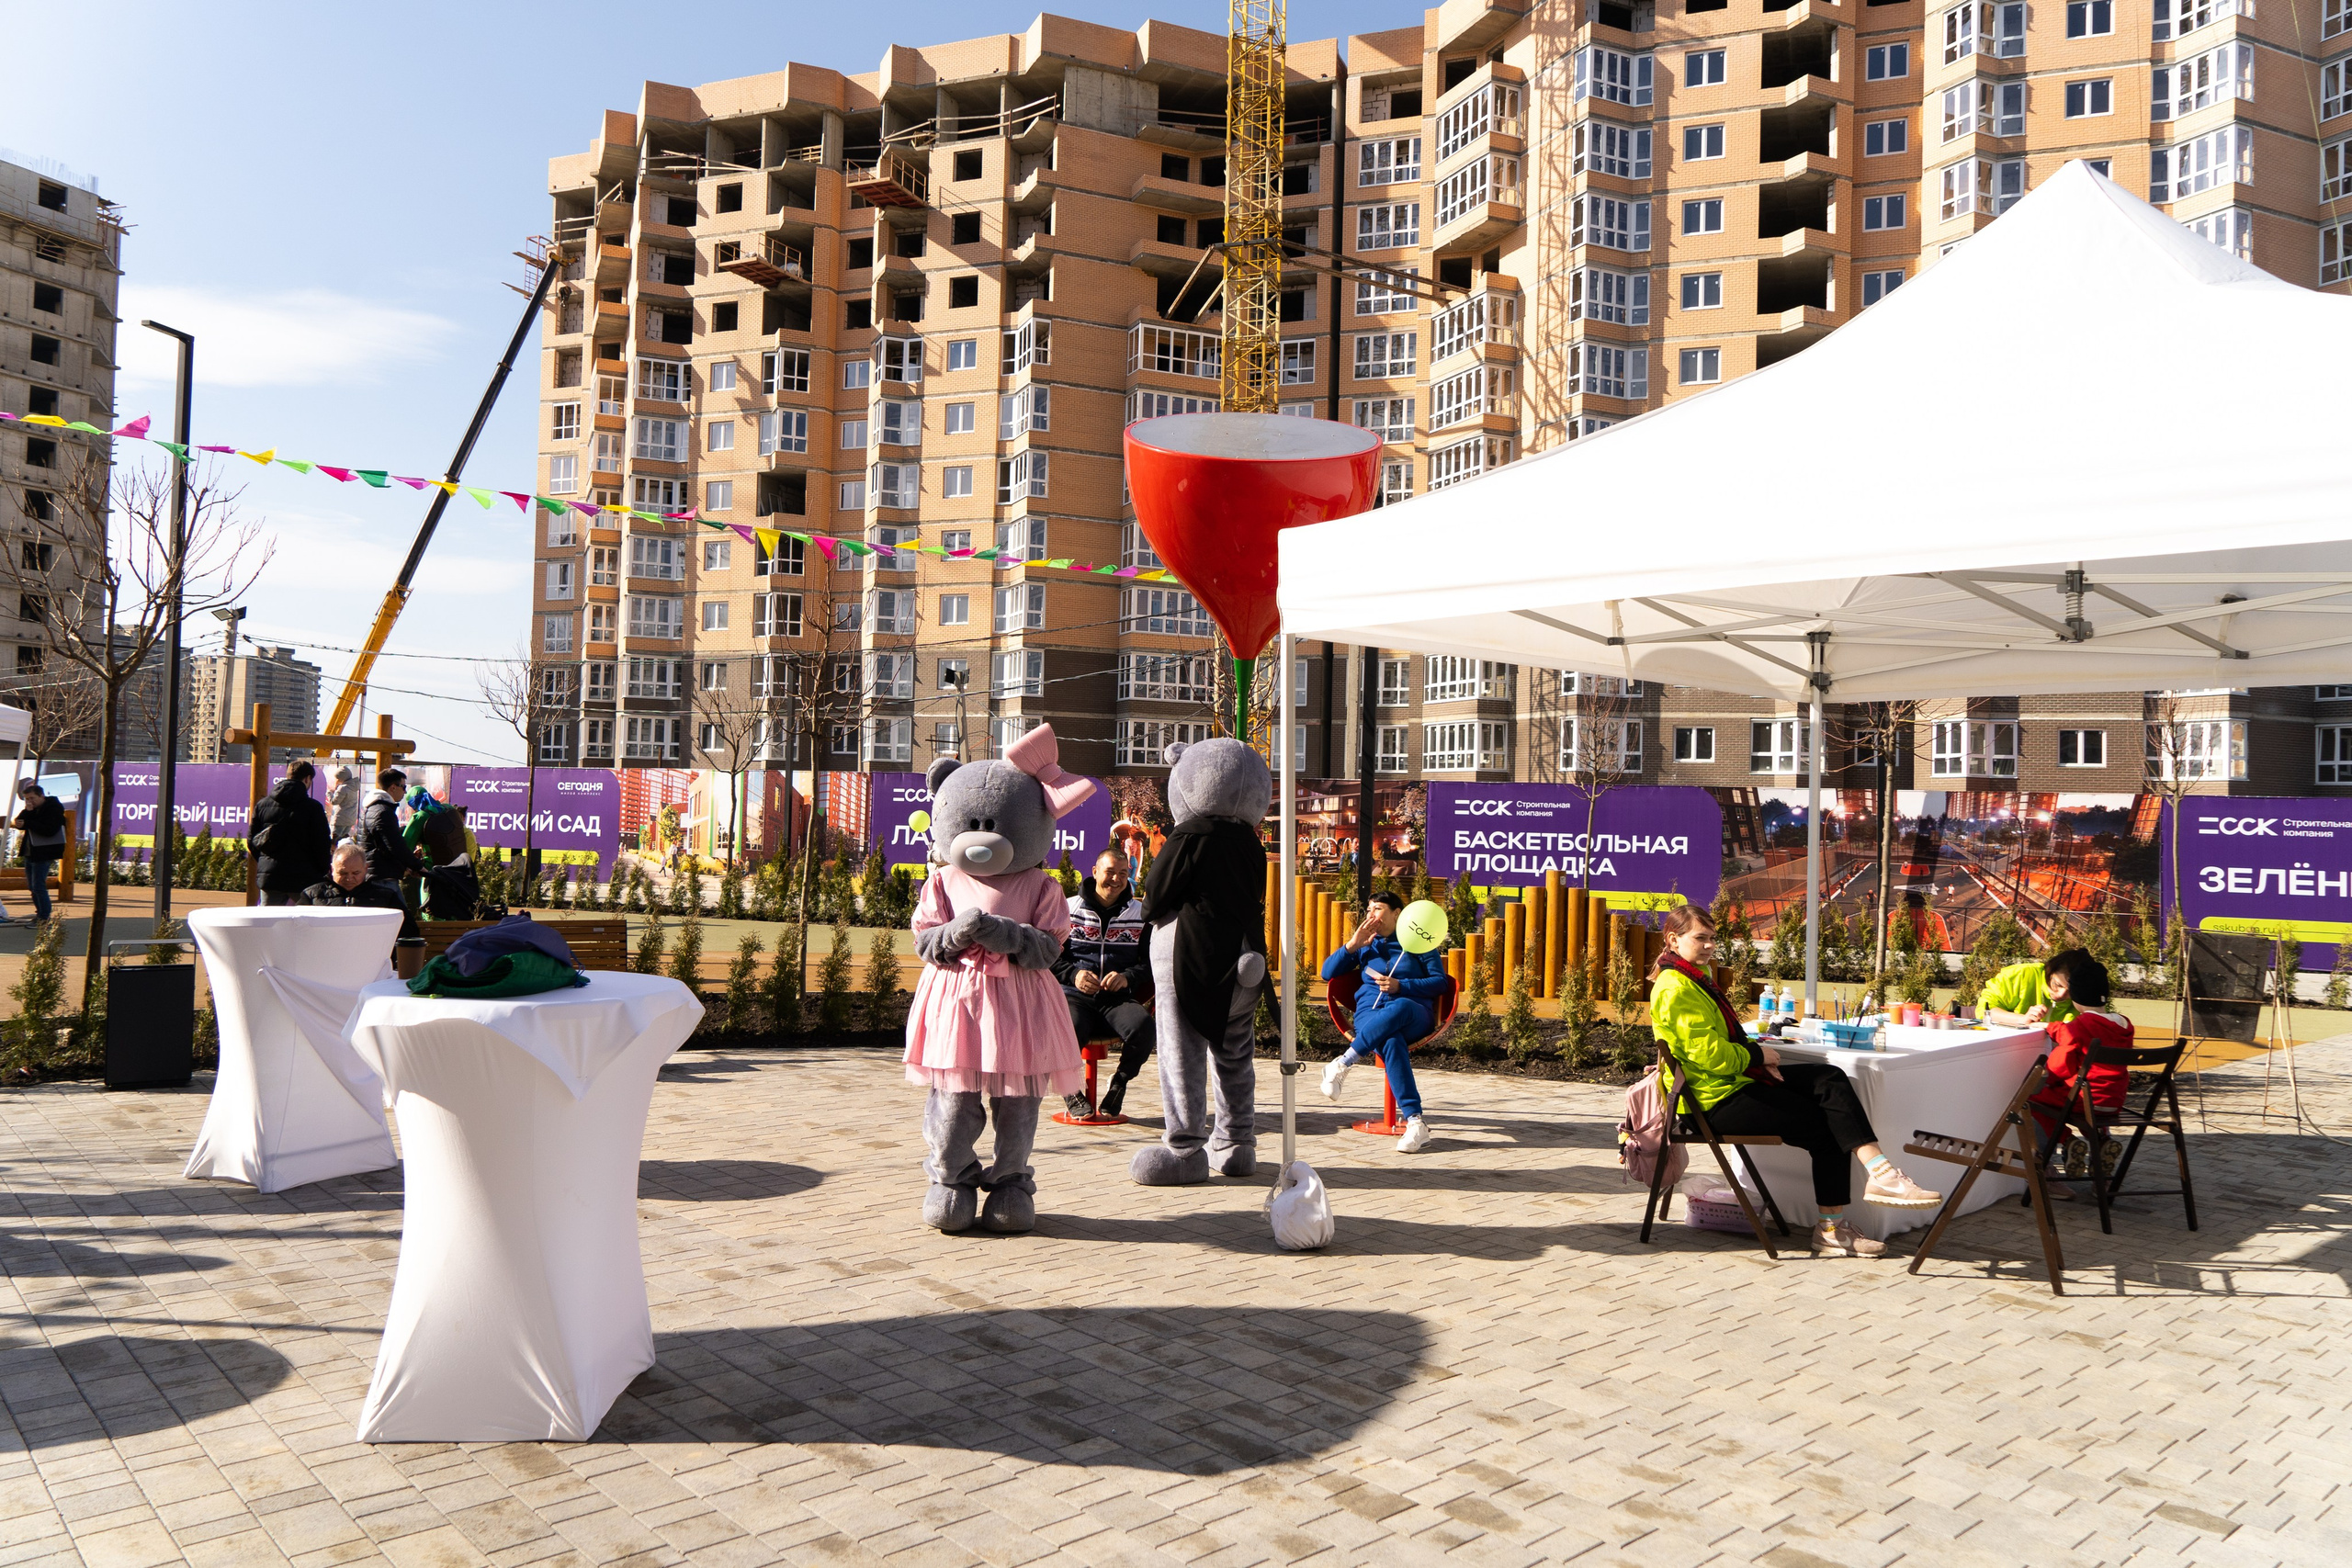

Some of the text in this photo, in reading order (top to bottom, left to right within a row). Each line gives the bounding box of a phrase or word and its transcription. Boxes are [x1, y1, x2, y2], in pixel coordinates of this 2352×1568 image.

[502, 780, 530, 788] Строительна
[557, 782, 604, 792] СЕГОДНЯ
[1516, 800, 1570, 809] Строительная
[117, 802, 209, 822] ТОРГВЫЙ
[1516, 809, 1553, 818] компания
[465, 809, 602, 837] ДЕТСКИЙ САД
[2283, 818, 2352, 828] Строительна
[2283, 829, 2334, 838] компания
[1454, 830, 1689, 855] БАСКЕТБОЛЬНАЯ
[1453, 853, 1617, 879] ПЛОЩАДКА
[2199, 862, 2352, 898] ЗЕЛЁН
